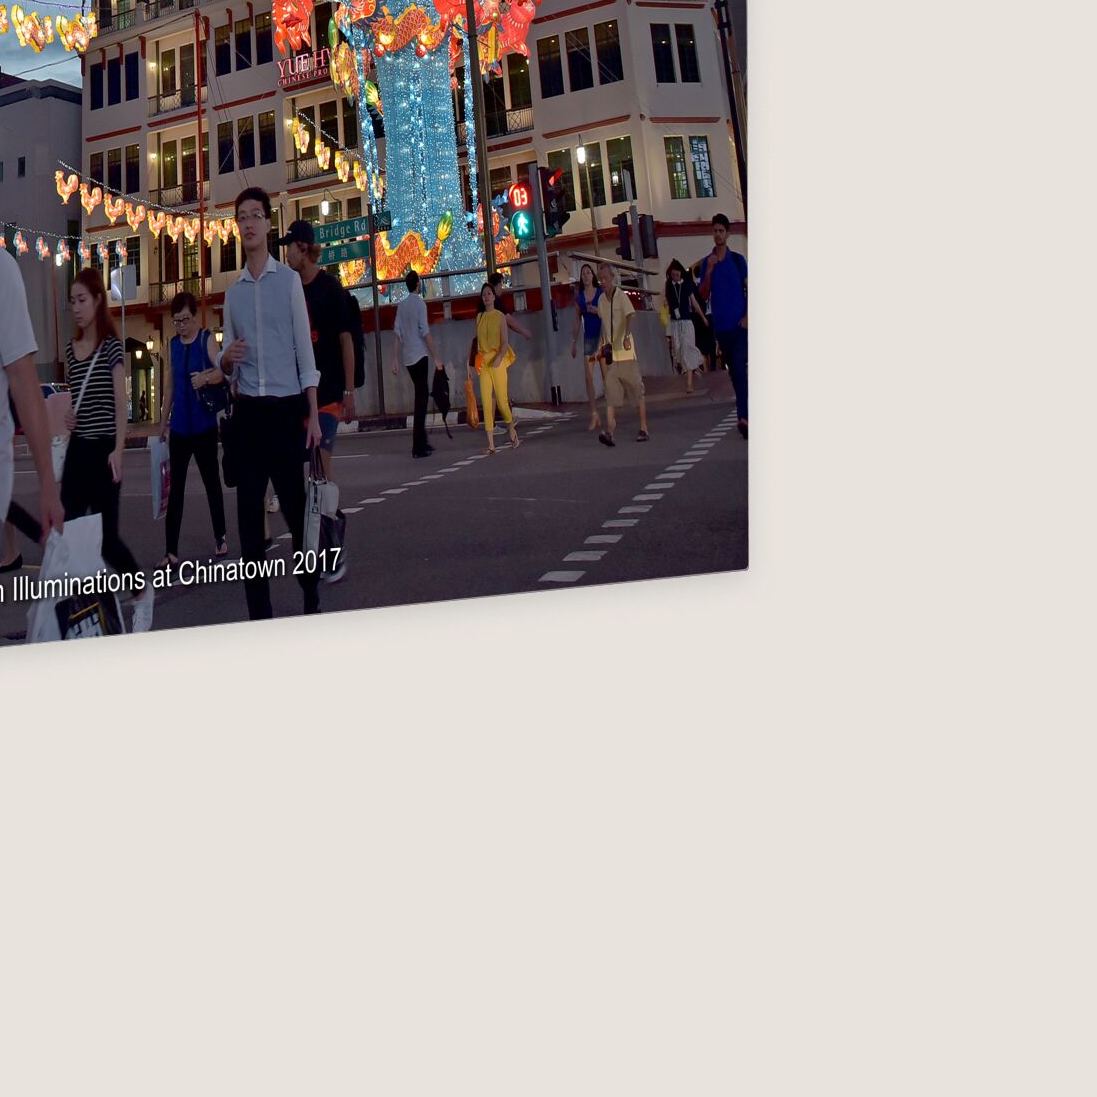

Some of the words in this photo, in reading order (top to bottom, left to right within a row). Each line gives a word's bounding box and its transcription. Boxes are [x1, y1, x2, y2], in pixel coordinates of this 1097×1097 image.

[277, 53, 309, 78] YUE
[277, 72, 310, 87] CHINESE
[313, 67, 329, 78] PRO
[513, 188, 528, 206] 03
[319, 224, 351, 239] Bridge
[354, 219, 366, 232] Rd
